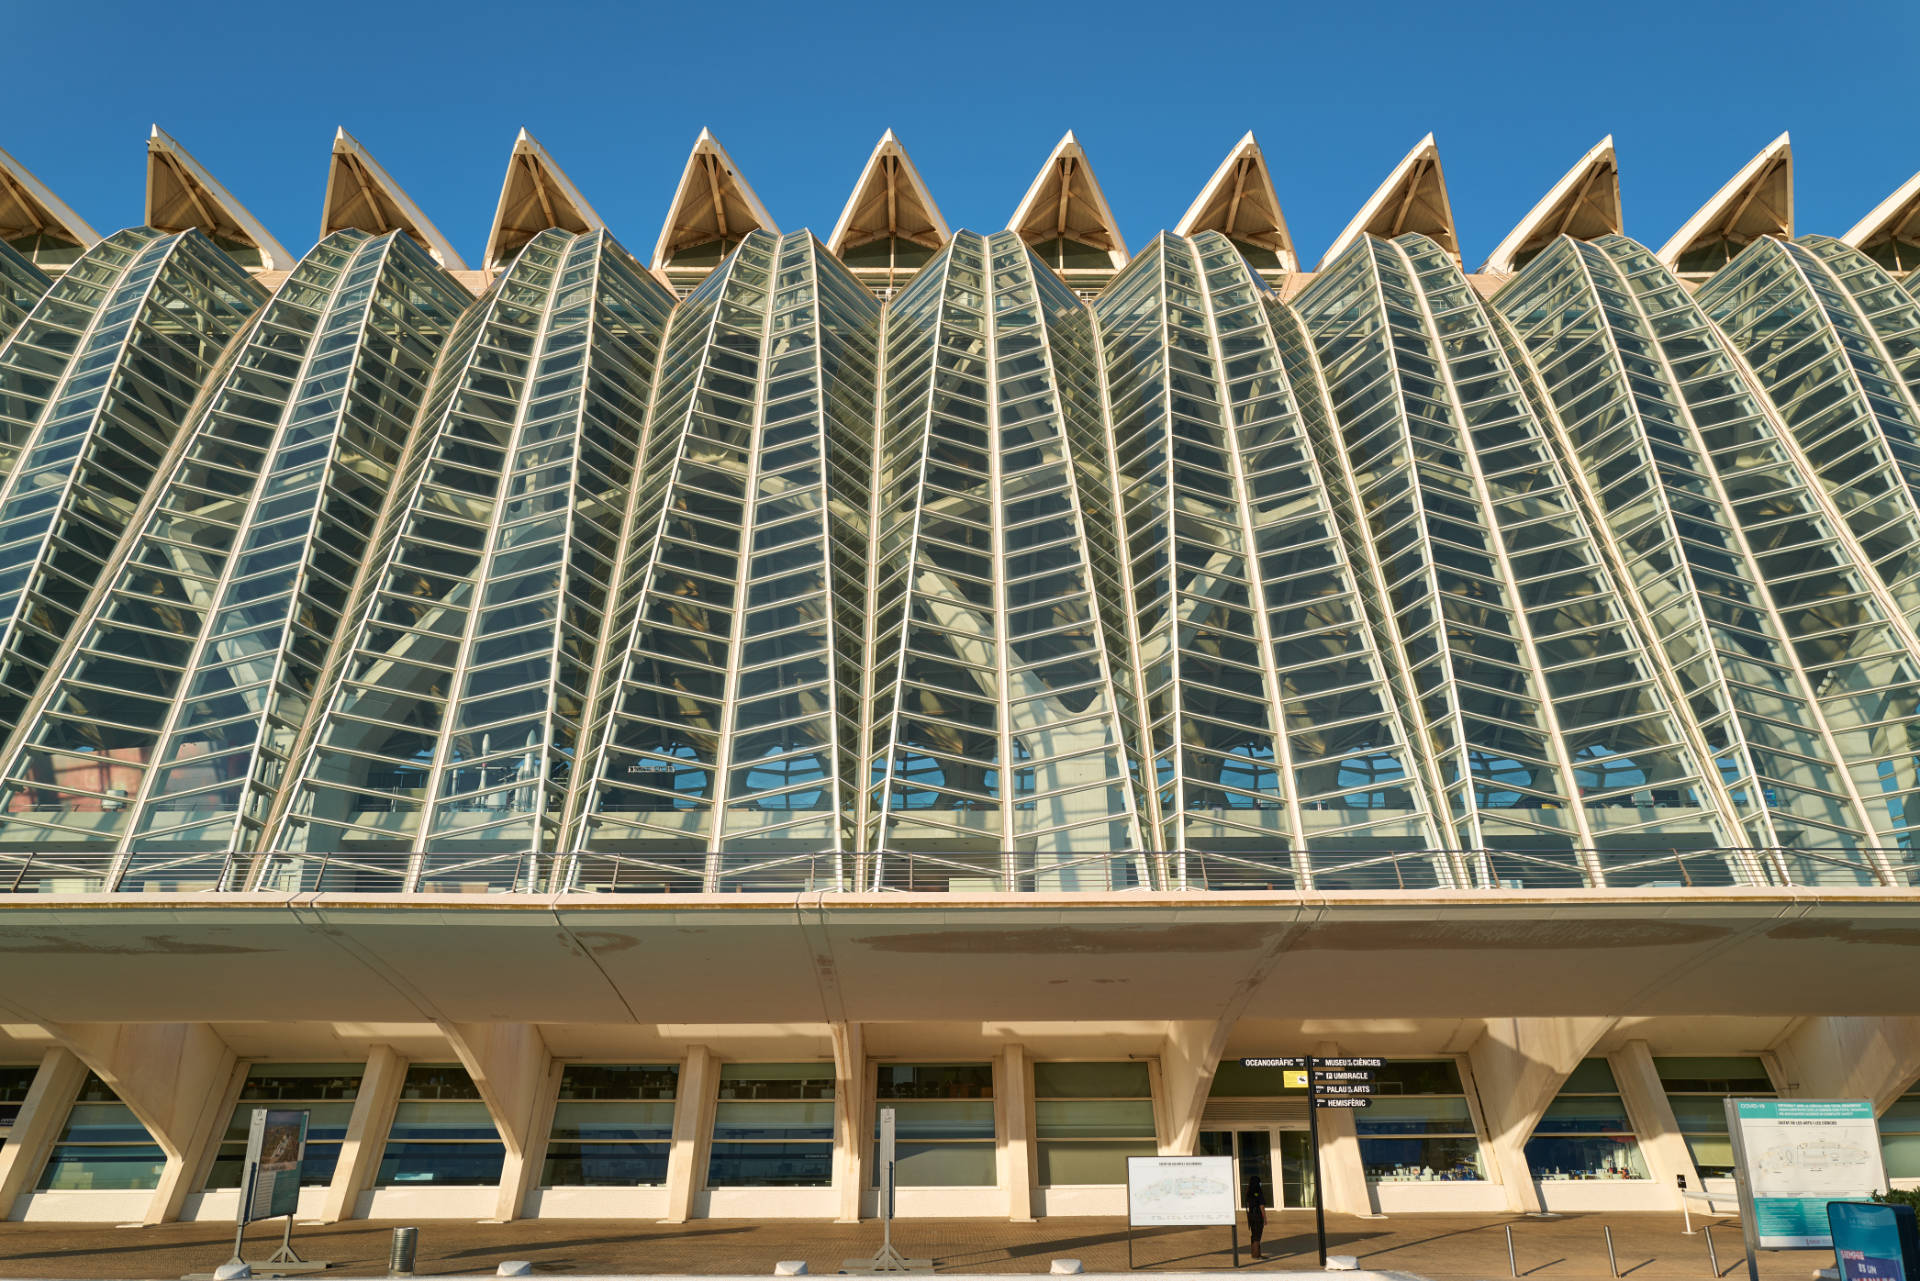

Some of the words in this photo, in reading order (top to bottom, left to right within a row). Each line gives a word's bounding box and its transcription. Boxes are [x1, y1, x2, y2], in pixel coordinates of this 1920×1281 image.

[1245, 1058, 1294, 1067] OCEANOGRÀFIC
[1325, 1059, 1347, 1067] MUSEU
[1353, 1058, 1381, 1067] CIÈNCIES
[1333, 1072, 1368, 1080] UMBRACLE
[1327, 1085, 1347, 1093] PALAU
[1353, 1085, 1370, 1093] ARTS
[1328, 1098, 1366, 1107] HEMISFÈRIC
